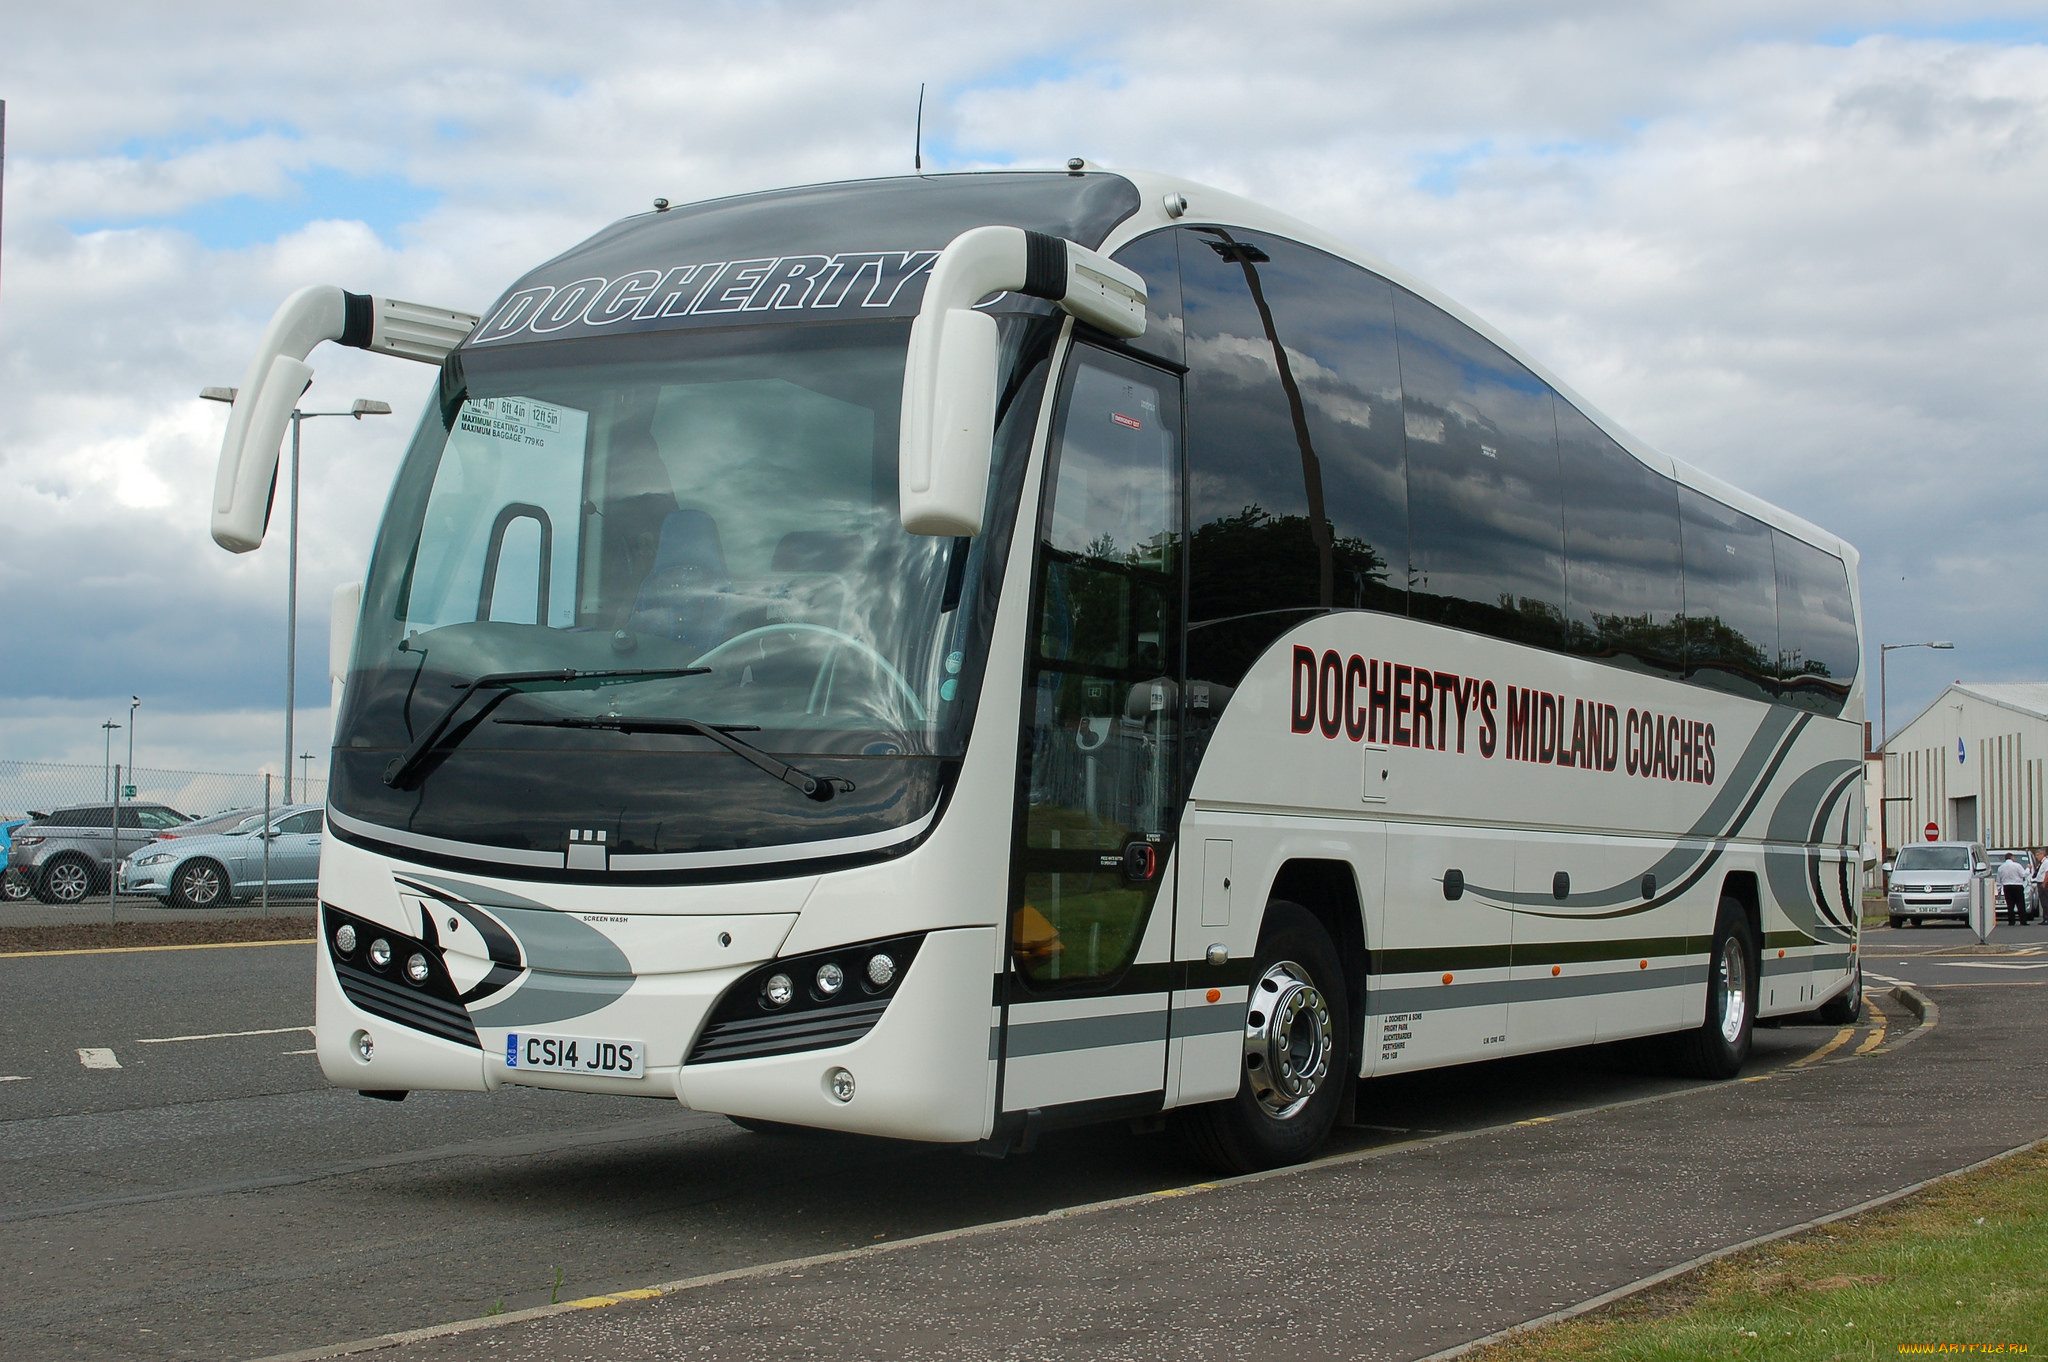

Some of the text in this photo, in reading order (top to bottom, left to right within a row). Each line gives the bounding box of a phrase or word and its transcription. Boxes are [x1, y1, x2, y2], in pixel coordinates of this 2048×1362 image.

[472, 250, 1008, 346] DOCHERTY
[501, 401, 512, 415] 8ft
[514, 405, 525, 418] 4in
[533, 409, 546, 422] 12ft
[547, 412, 558, 425] 5in
[461, 413, 492, 427] MAXIMUM
[493, 420, 518, 433] SEATING
[520, 427, 526, 435] 51
[461, 422, 491, 436] MAXIMUM
[492, 430, 521, 443] BAGGAGE
[1291, 644, 1716, 786] DOCHERTY'S MIDLAND COACHES
[1389, 1014, 1408, 1023] DOCHERTY
[1383, 1023, 1408, 1032] PRIORY PARK
[1383, 1032, 1412, 1042] AUCHTERARDER
[526, 1038, 633, 1072] CS14 JDS
[1382, 1042, 1405, 1051] PERTHSHIRE
